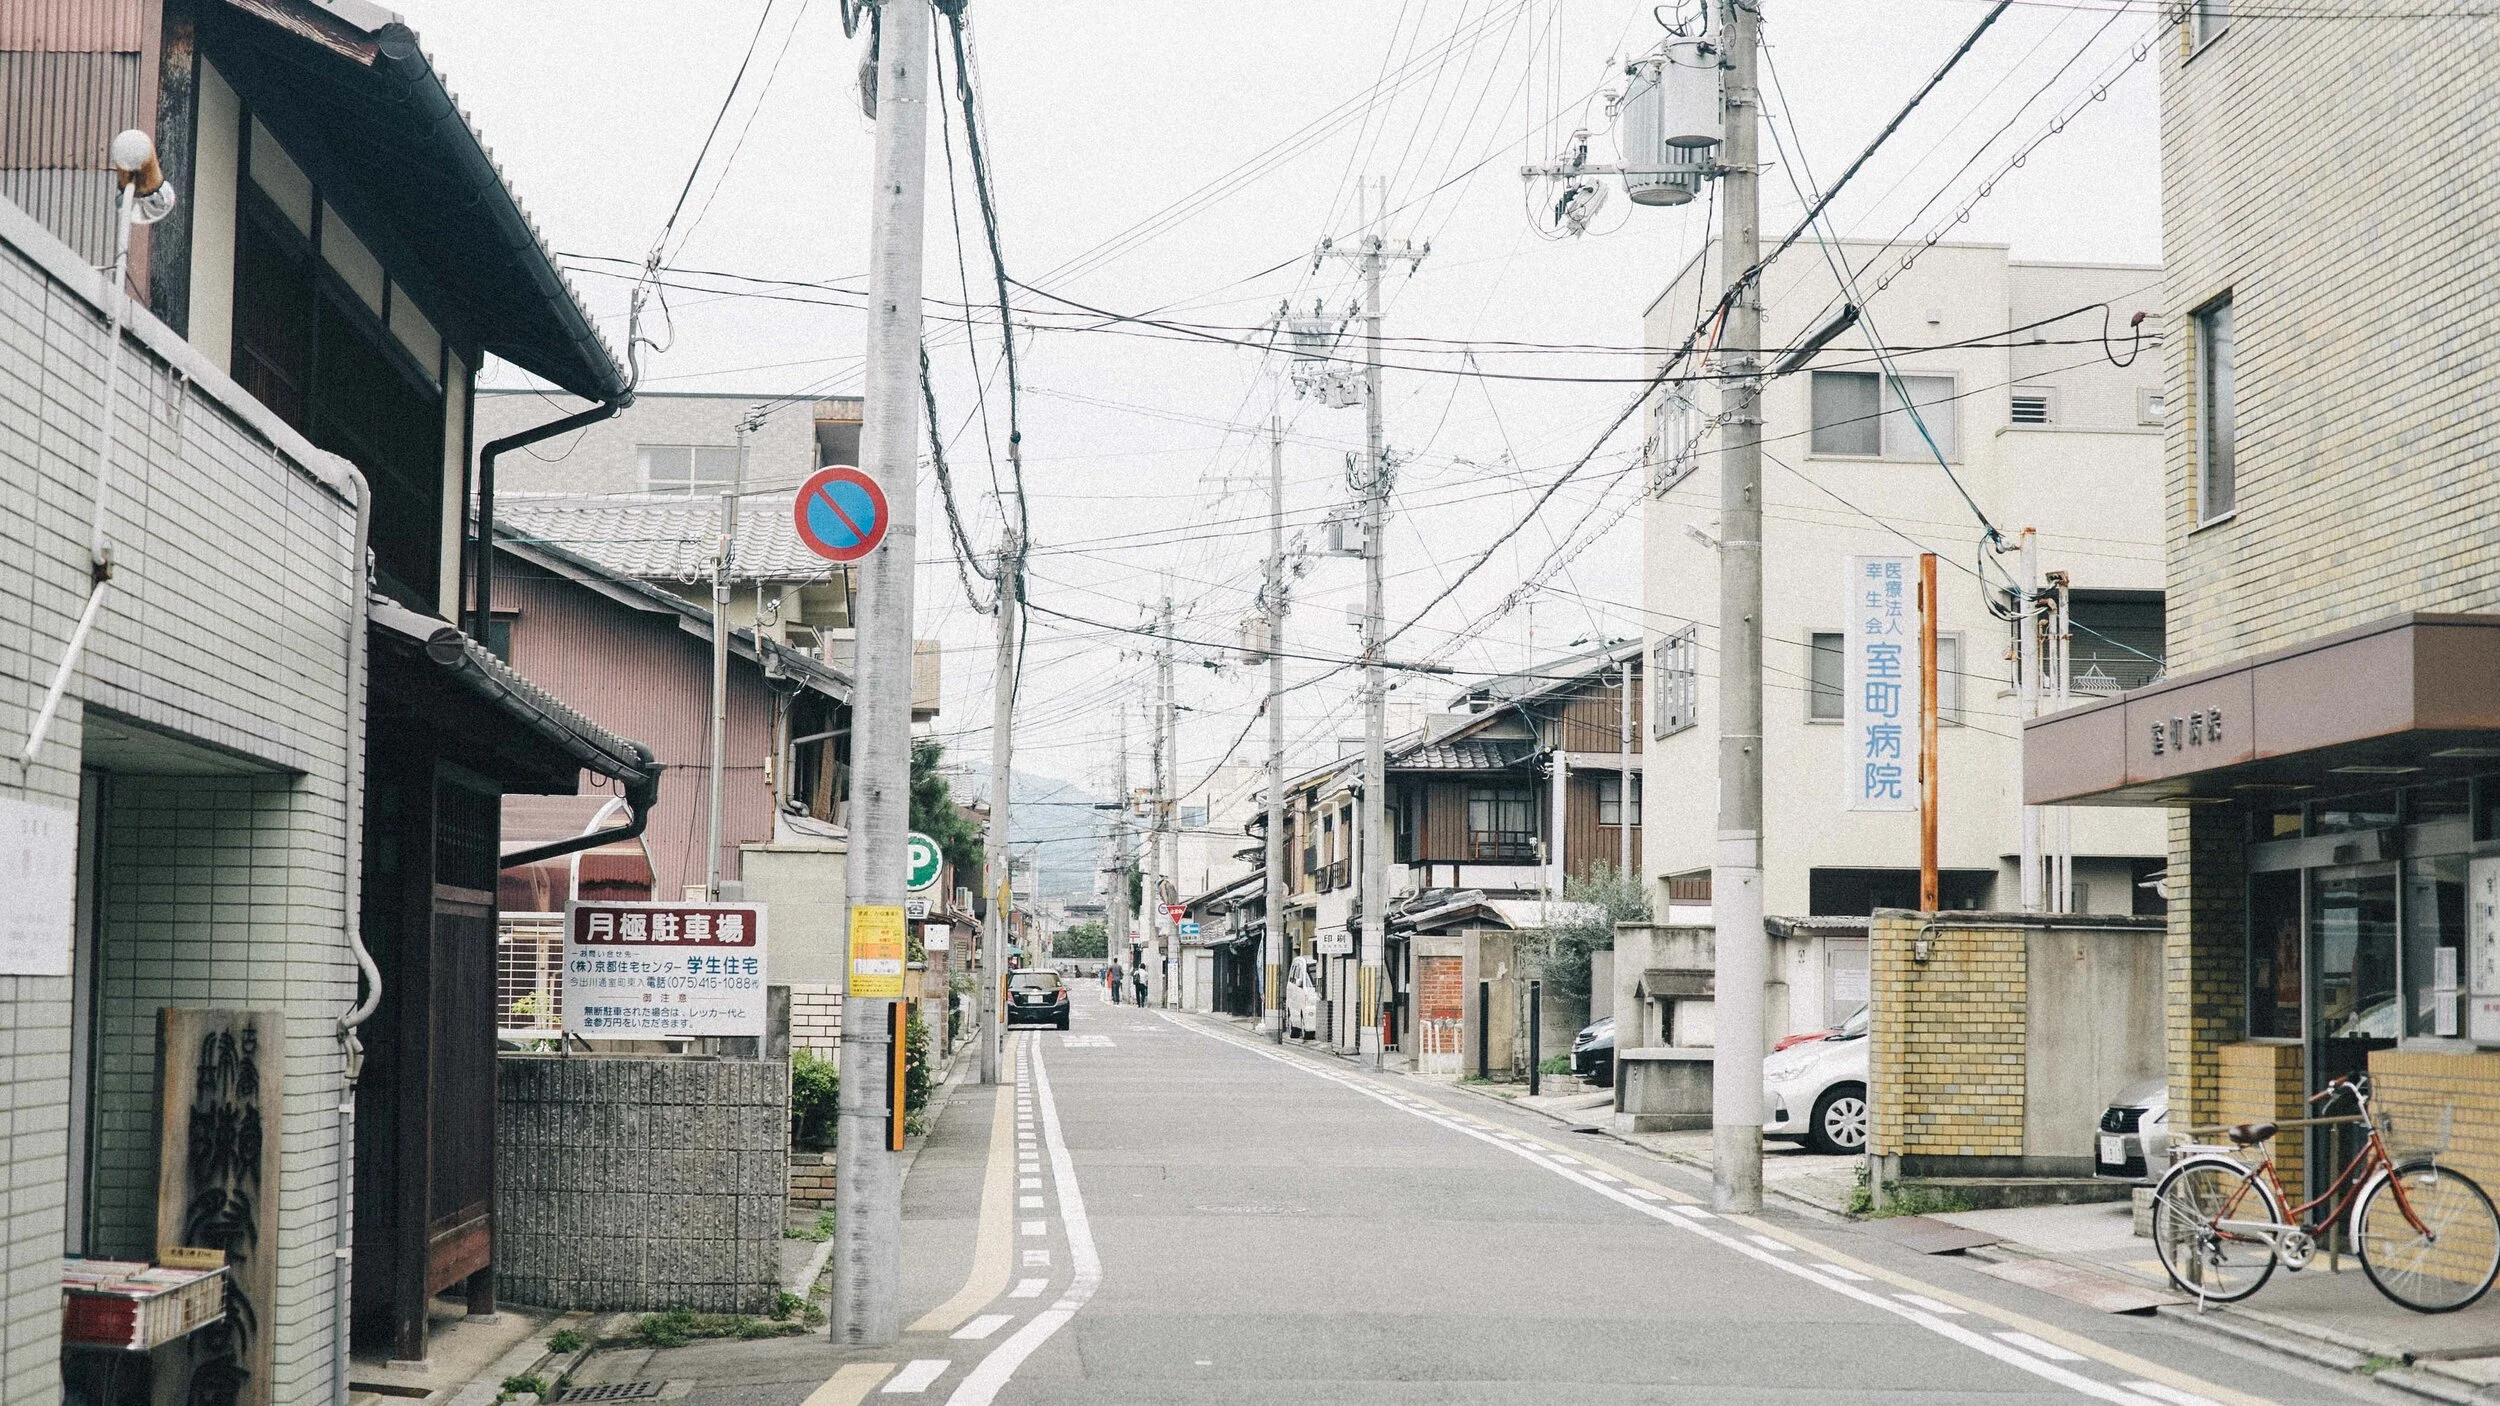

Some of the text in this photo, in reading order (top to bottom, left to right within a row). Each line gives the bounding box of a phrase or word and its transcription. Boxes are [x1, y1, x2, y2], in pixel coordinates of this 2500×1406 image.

[1865, 562, 1883, 636] 幸生会
[1885, 562, 1903, 636] 医療法人
[1865, 640, 1902, 800] 室町病院
[2151, 705, 2222, 756] 室町病院
[906, 843, 932, 881] P
[586, 912, 745, 943] 月極駐車場
[687, 955, 758, 975] 学生住宅
